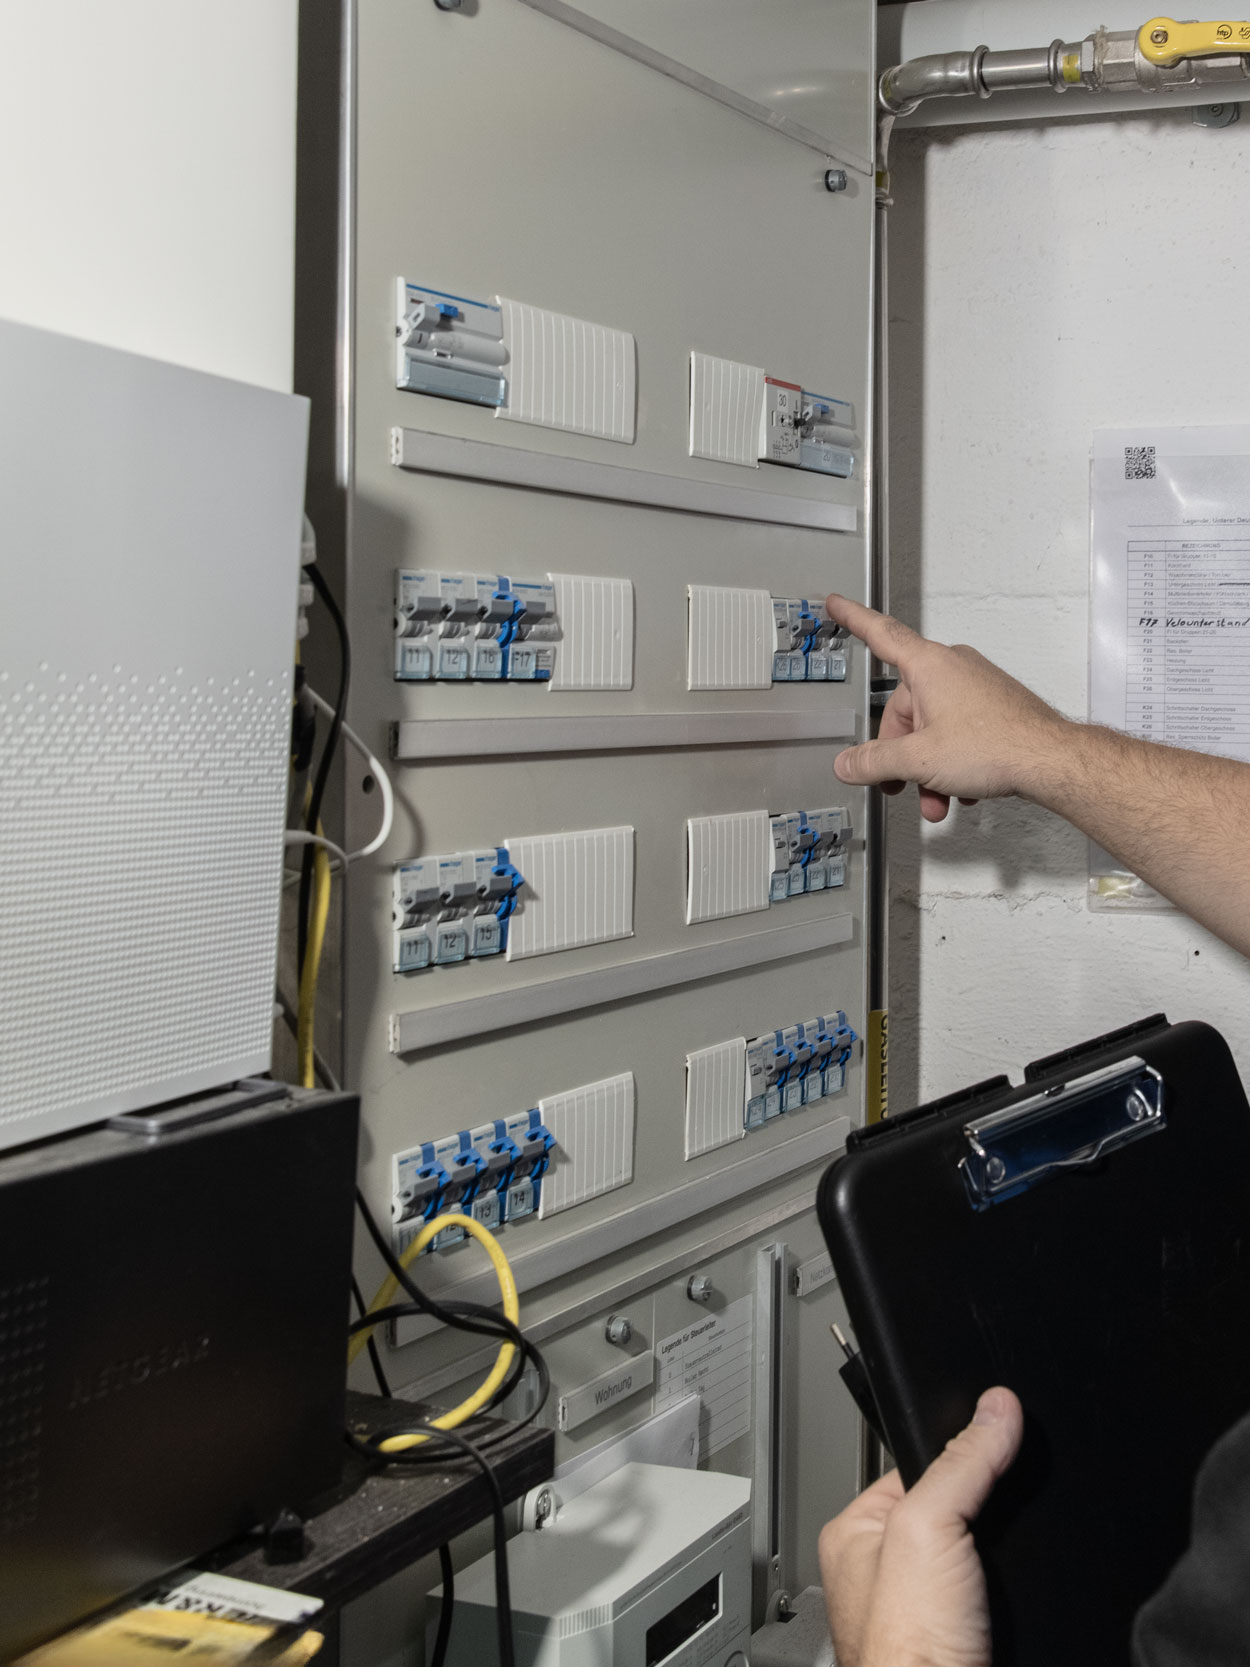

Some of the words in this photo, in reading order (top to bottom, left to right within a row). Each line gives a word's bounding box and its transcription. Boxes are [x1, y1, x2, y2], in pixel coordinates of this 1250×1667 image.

[778, 393, 787, 408] 30
[1139, 618, 1159, 627] F17
[514, 1191, 525, 1206] 14
[480, 1203, 492, 1219] 13
[661, 1338, 682, 1355] Legende
[682, 1333, 690, 1343] für
[595, 1375, 632, 1405] Wohnung
